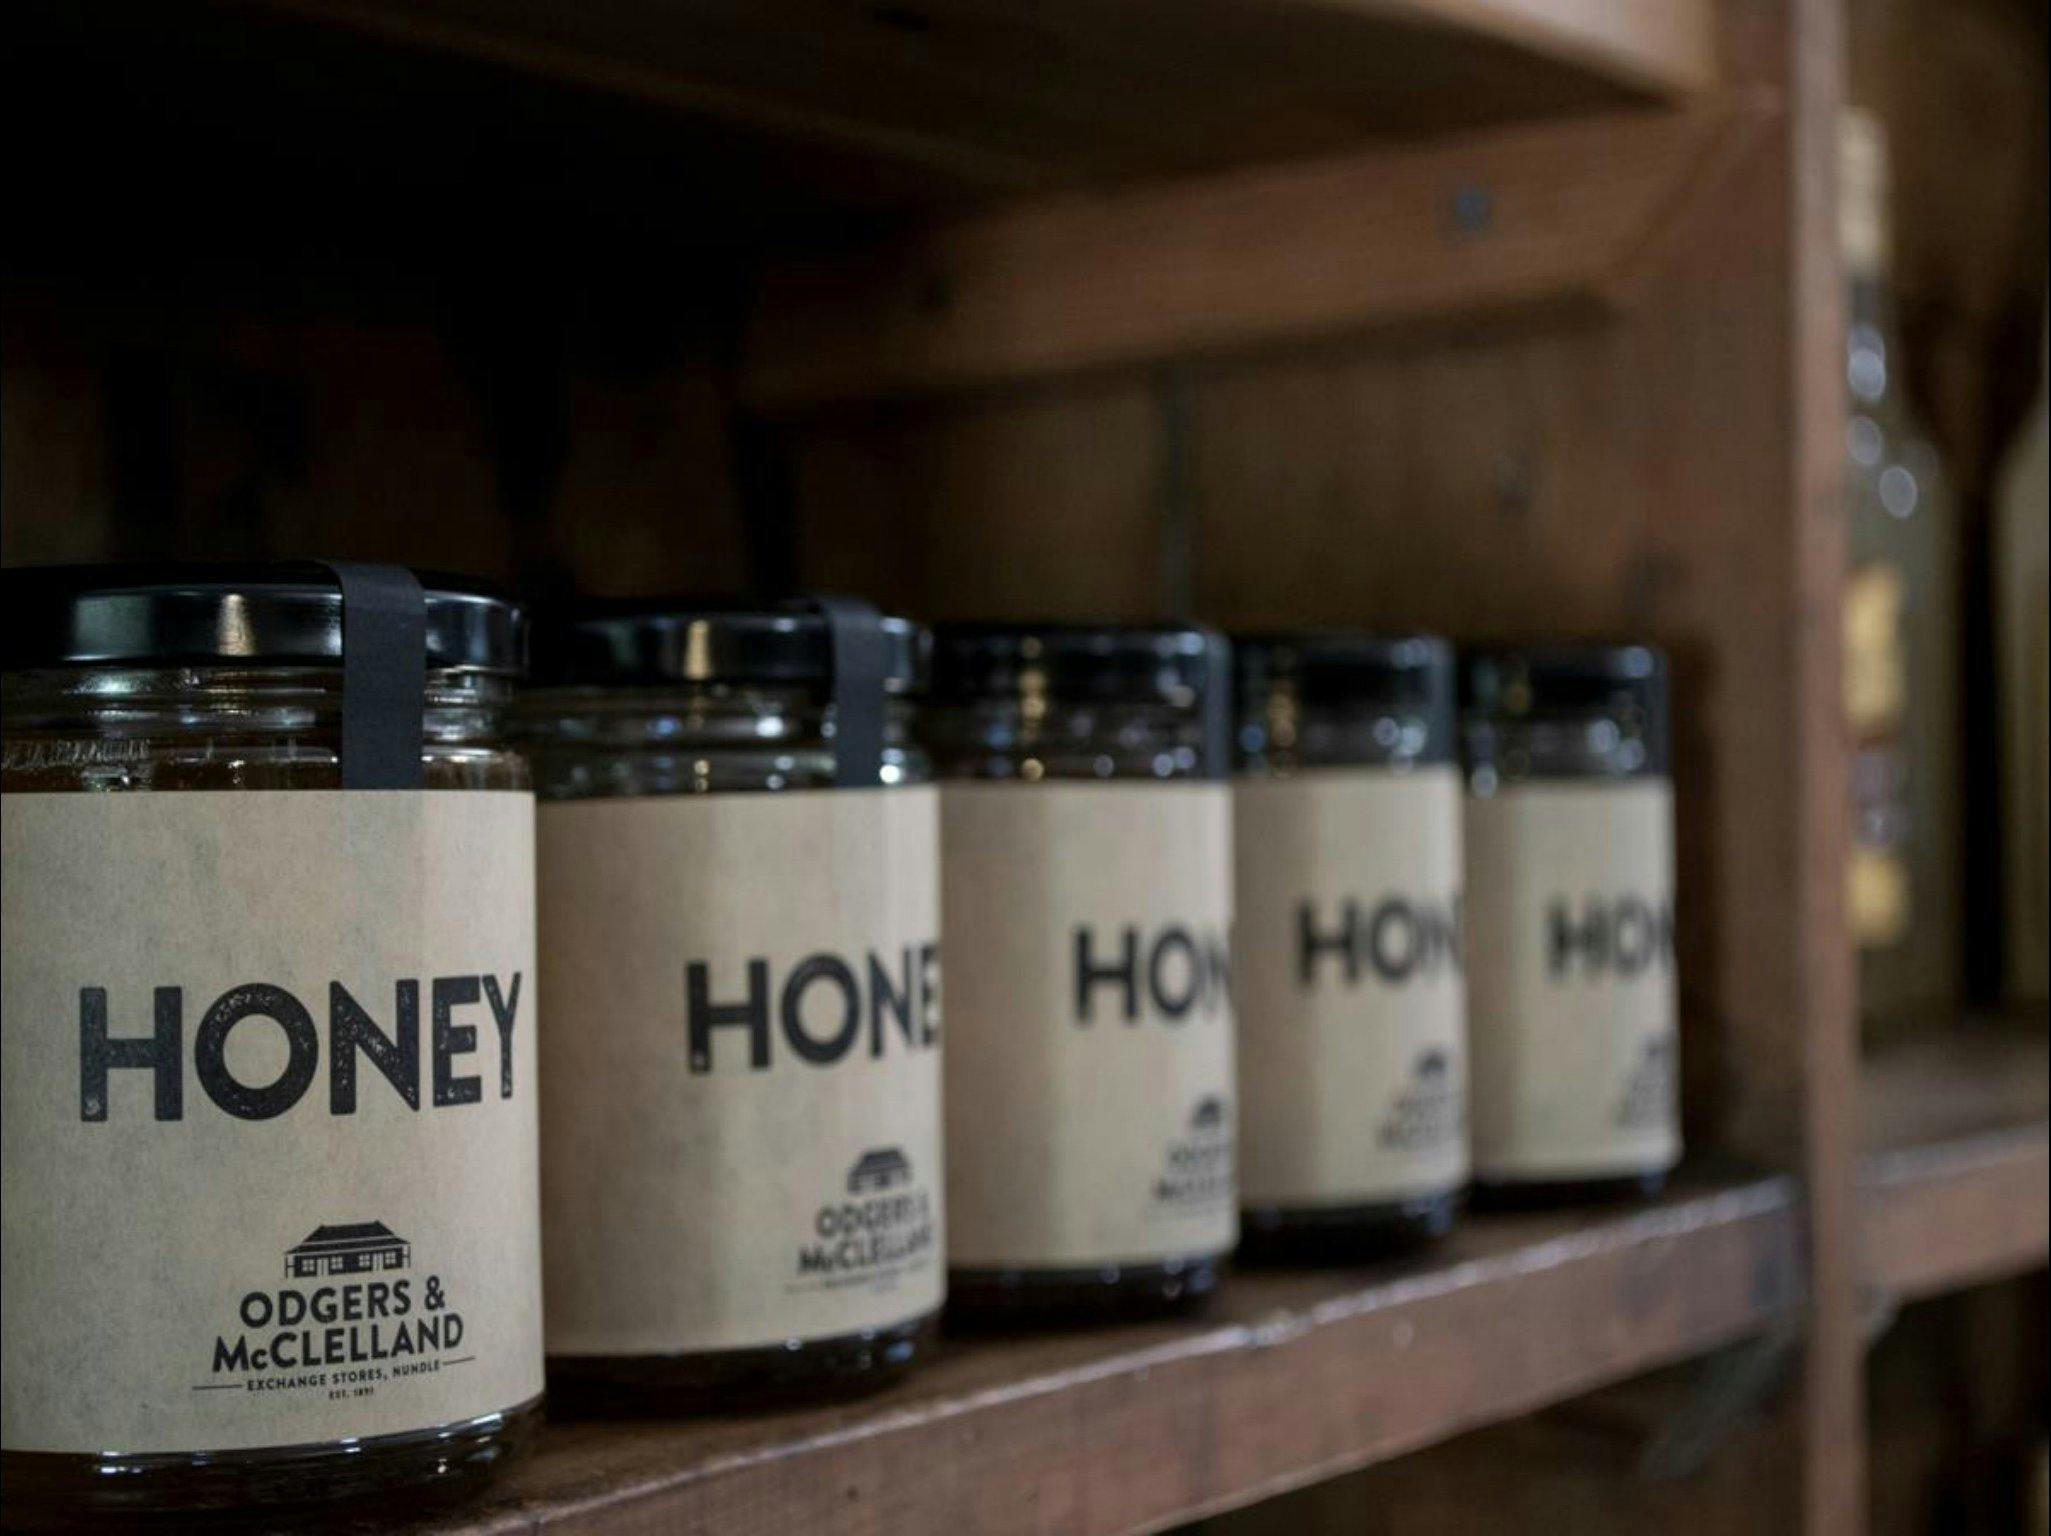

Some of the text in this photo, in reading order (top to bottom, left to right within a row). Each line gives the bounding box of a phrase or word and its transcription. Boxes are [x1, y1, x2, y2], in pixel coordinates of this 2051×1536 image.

[80, 971, 522, 1122] HONEY
[239, 1275, 446, 1328] ODGERS &
[212, 1313, 464, 1373] McCLELLAND
[247, 1359, 441, 1392] EXCHANGE STORES, NUNDLE
